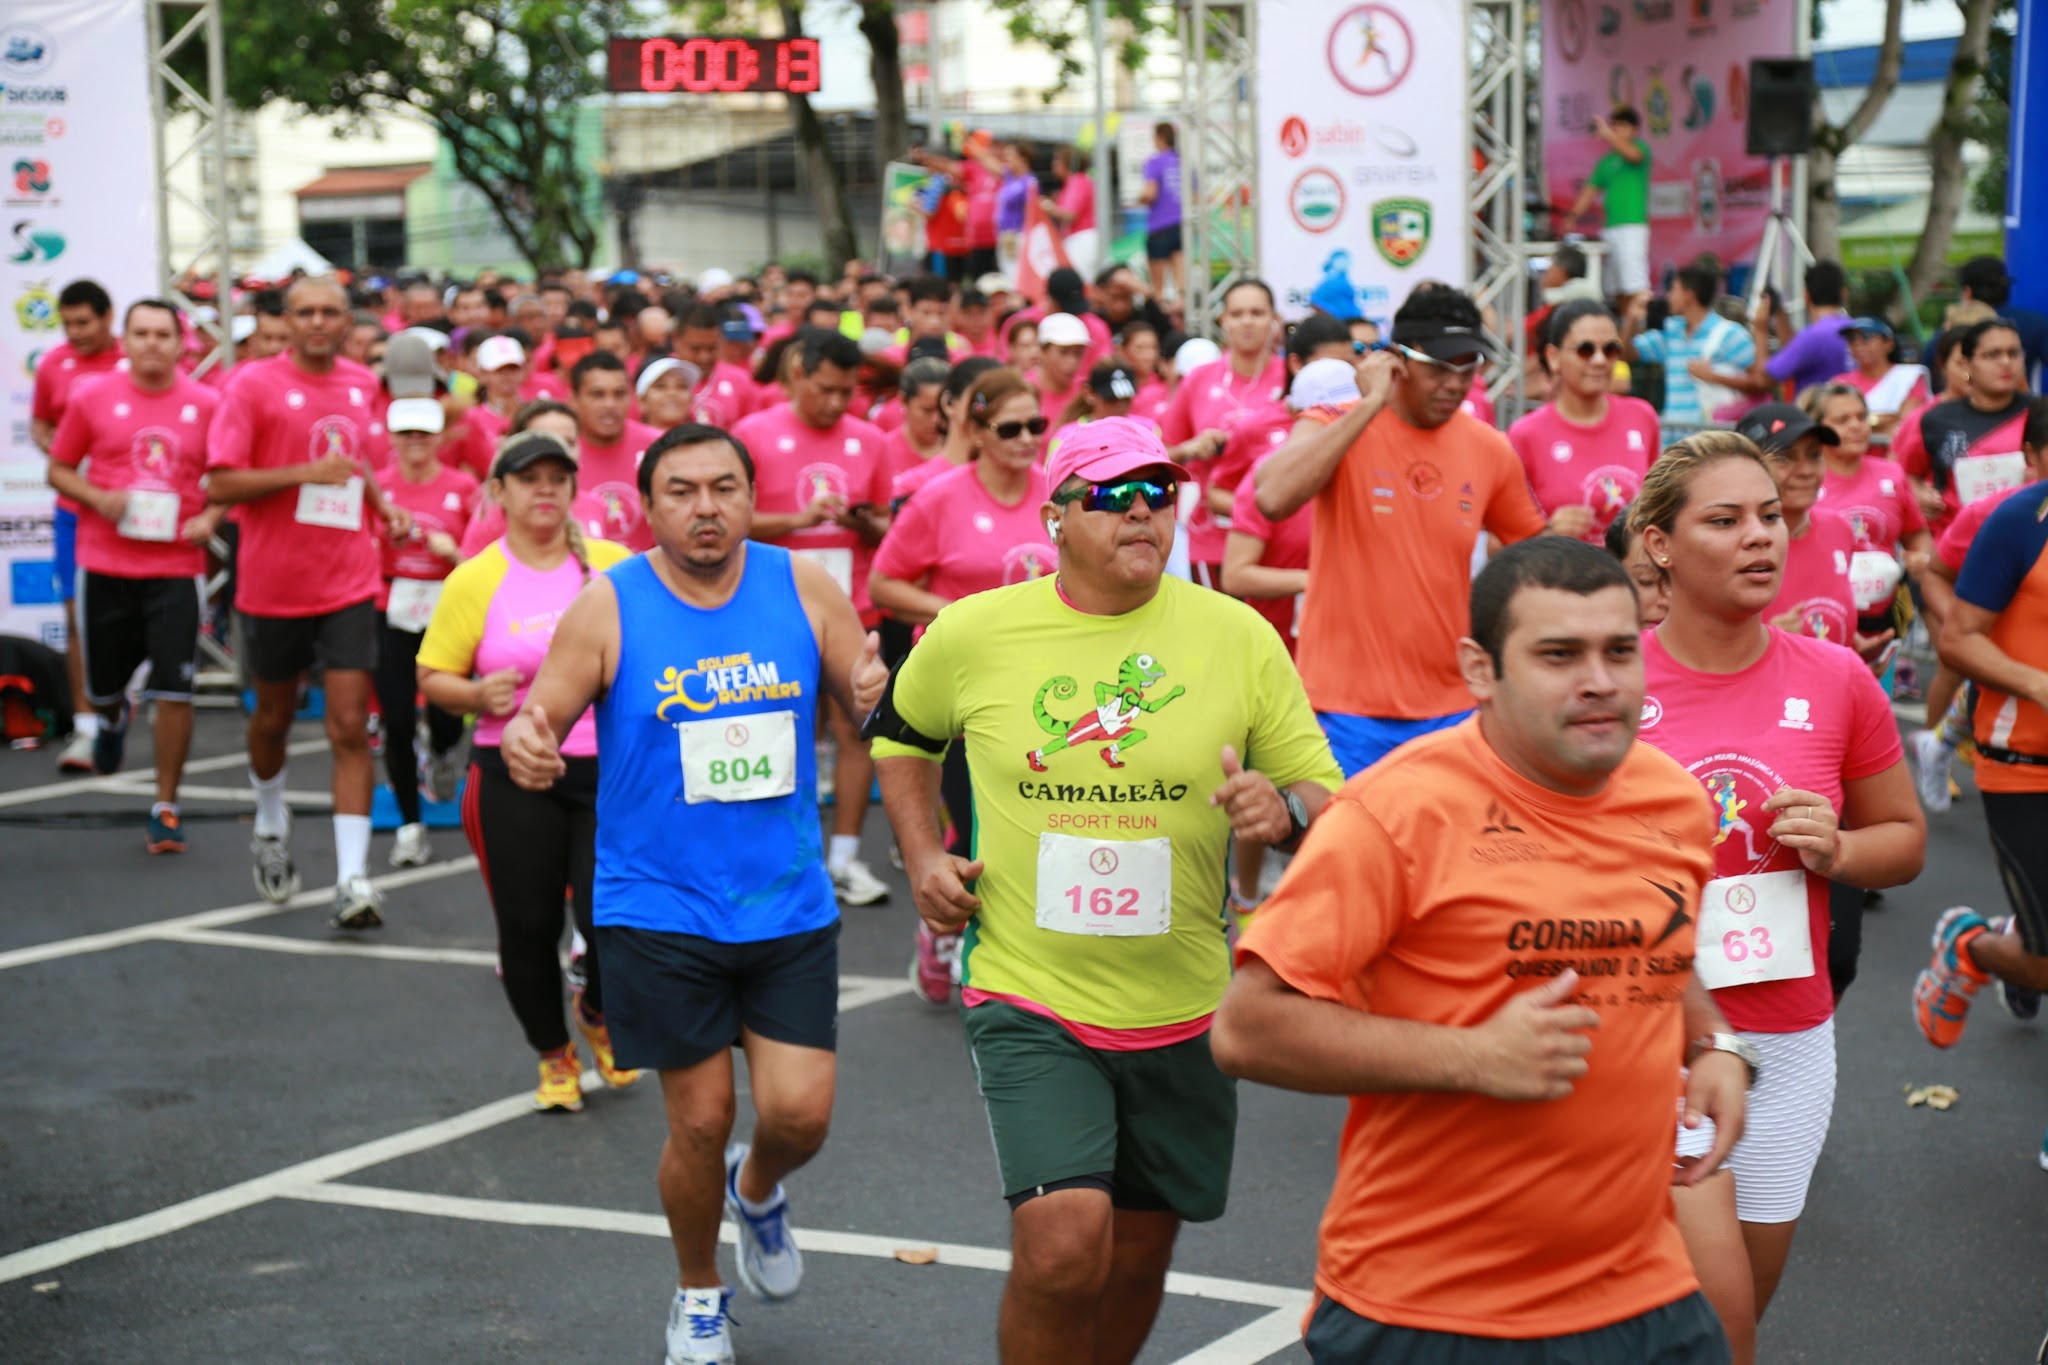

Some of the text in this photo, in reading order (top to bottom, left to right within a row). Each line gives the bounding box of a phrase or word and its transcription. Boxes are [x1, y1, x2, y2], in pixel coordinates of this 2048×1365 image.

[697, 652, 753, 672] EQUIPE
[705, 661, 781, 694] AFEAM
[708, 755, 773, 785] 804
[1018, 779, 1188, 803] CAMALEÃO
[1047, 813, 1158, 830] SPORT RUN
[1064, 885, 1140, 917] 162
[1507, 918, 1644, 950] CORRIDA
[1722, 926, 1775, 962] 63
